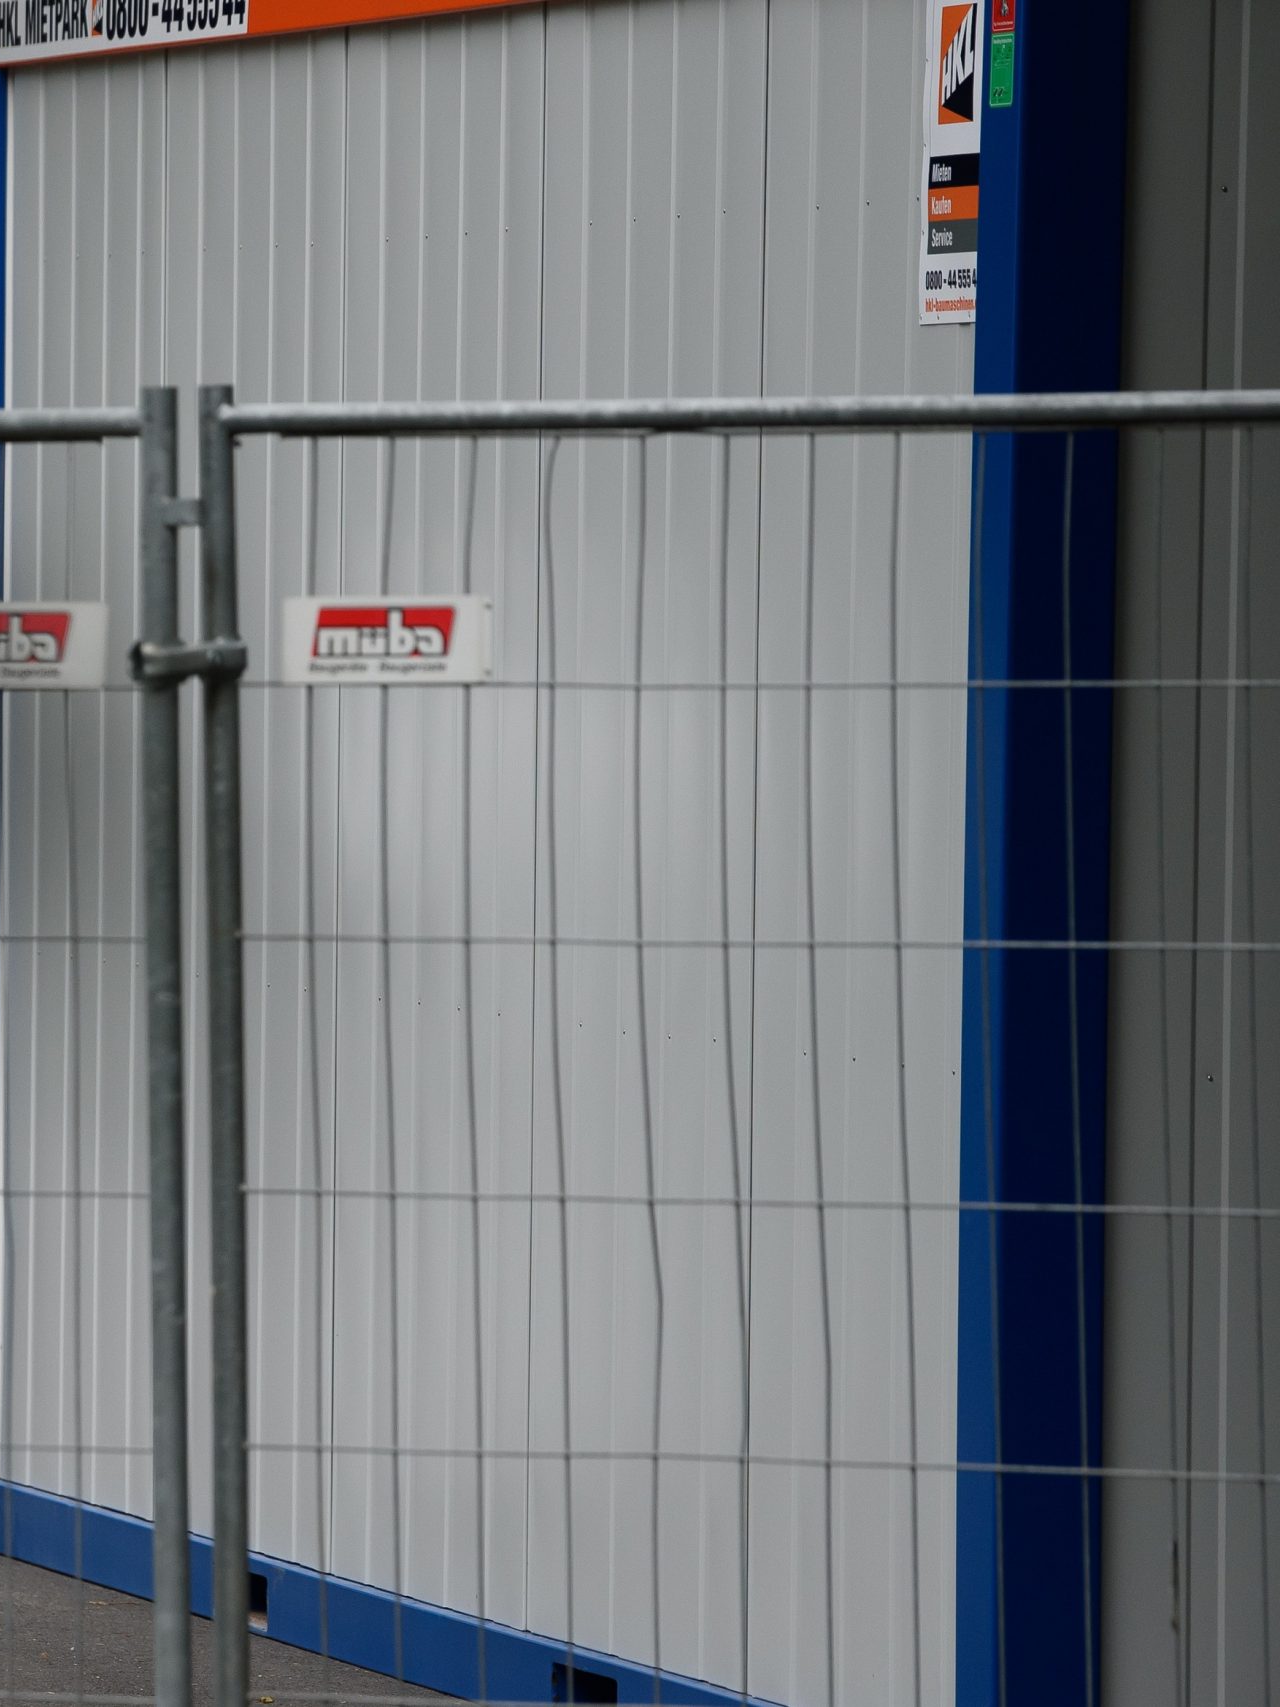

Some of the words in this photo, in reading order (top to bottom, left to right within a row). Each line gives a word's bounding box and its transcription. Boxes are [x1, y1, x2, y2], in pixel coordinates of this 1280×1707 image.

[25, 0, 89, 45] MIETPARK
[941, 3, 974, 106] HKL
[931, 163, 952, 182] Mieten
[931, 196, 952, 215] Kaufen
[931, 228, 953, 247] Service
[318, 608, 445, 656] müba
